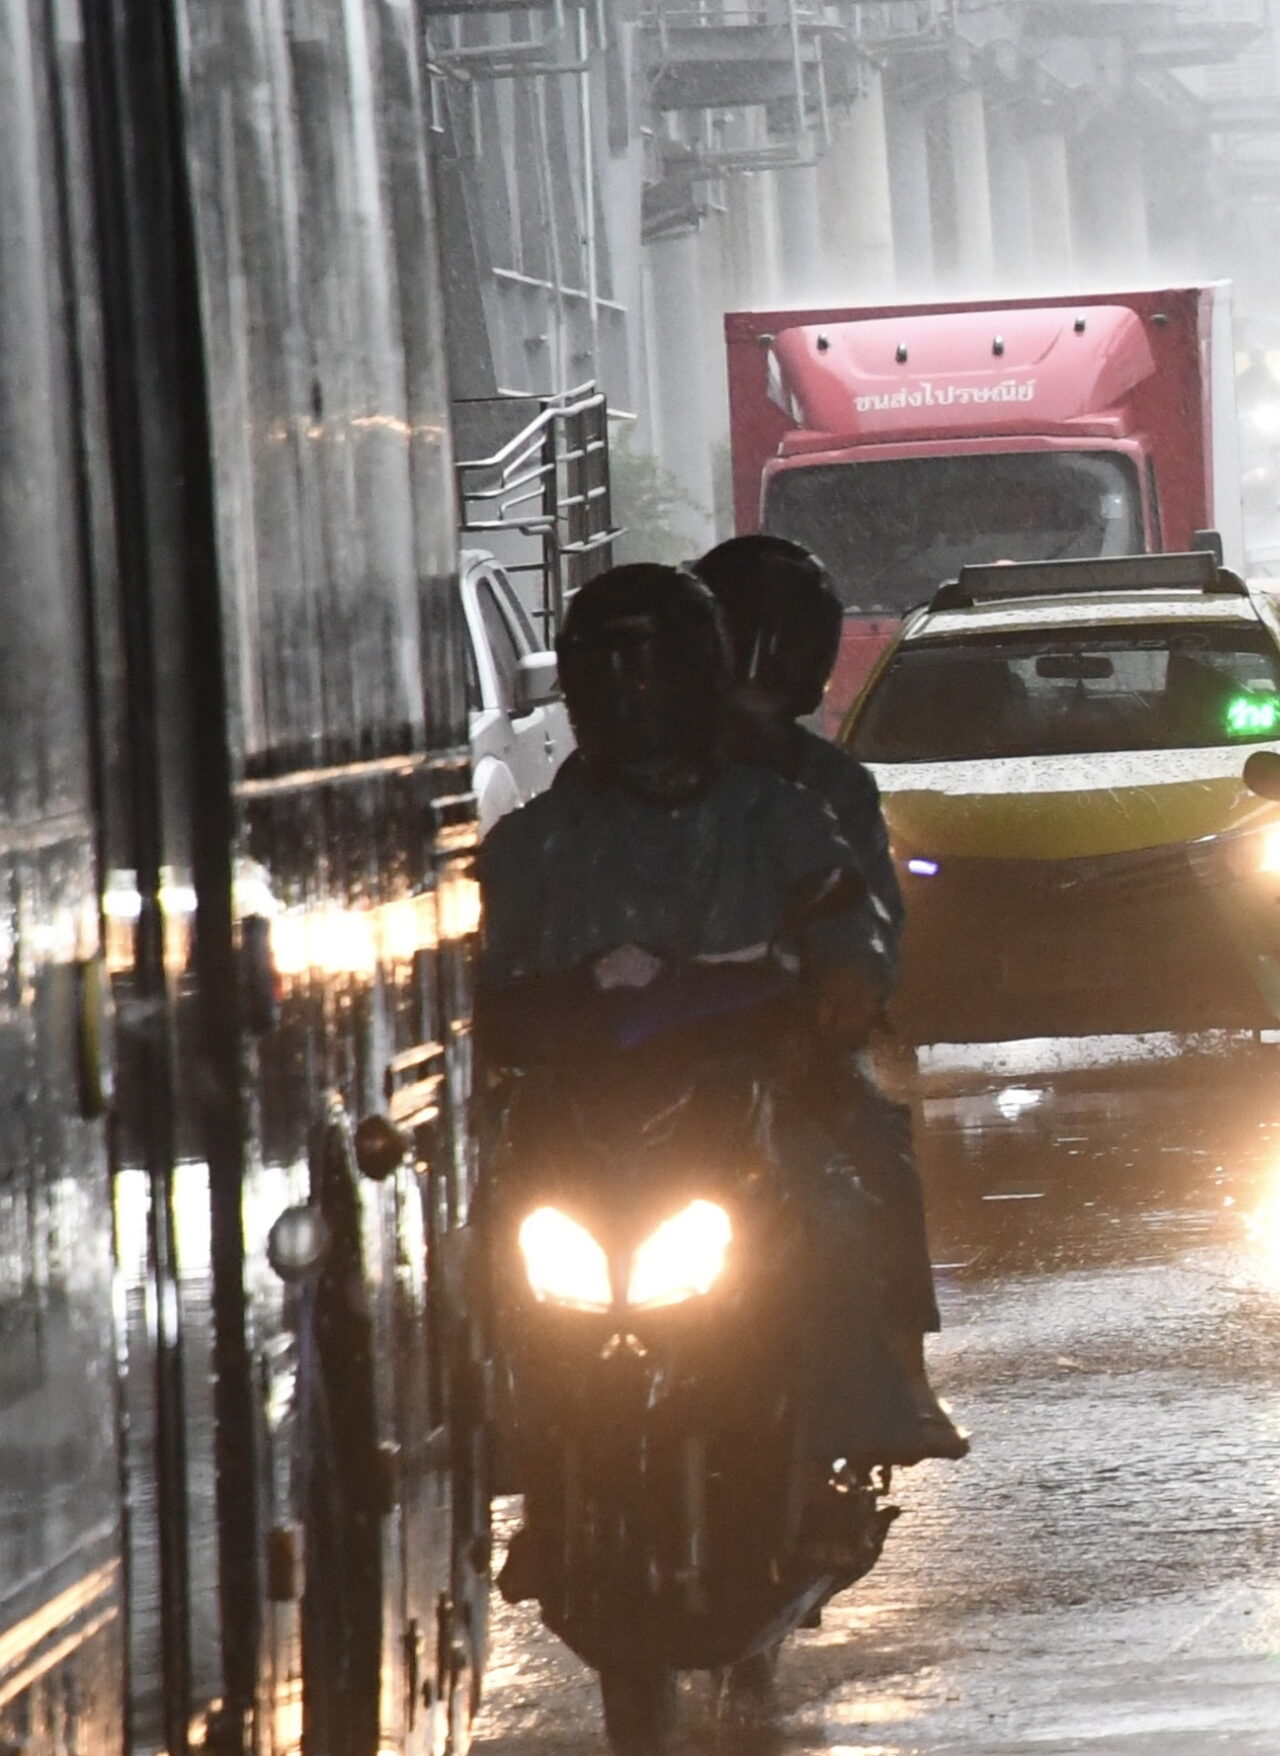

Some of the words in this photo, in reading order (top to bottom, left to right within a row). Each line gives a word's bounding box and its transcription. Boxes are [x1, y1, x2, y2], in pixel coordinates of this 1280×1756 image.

[853, 379, 1037, 412] ขนส่งไปรษณีย์
